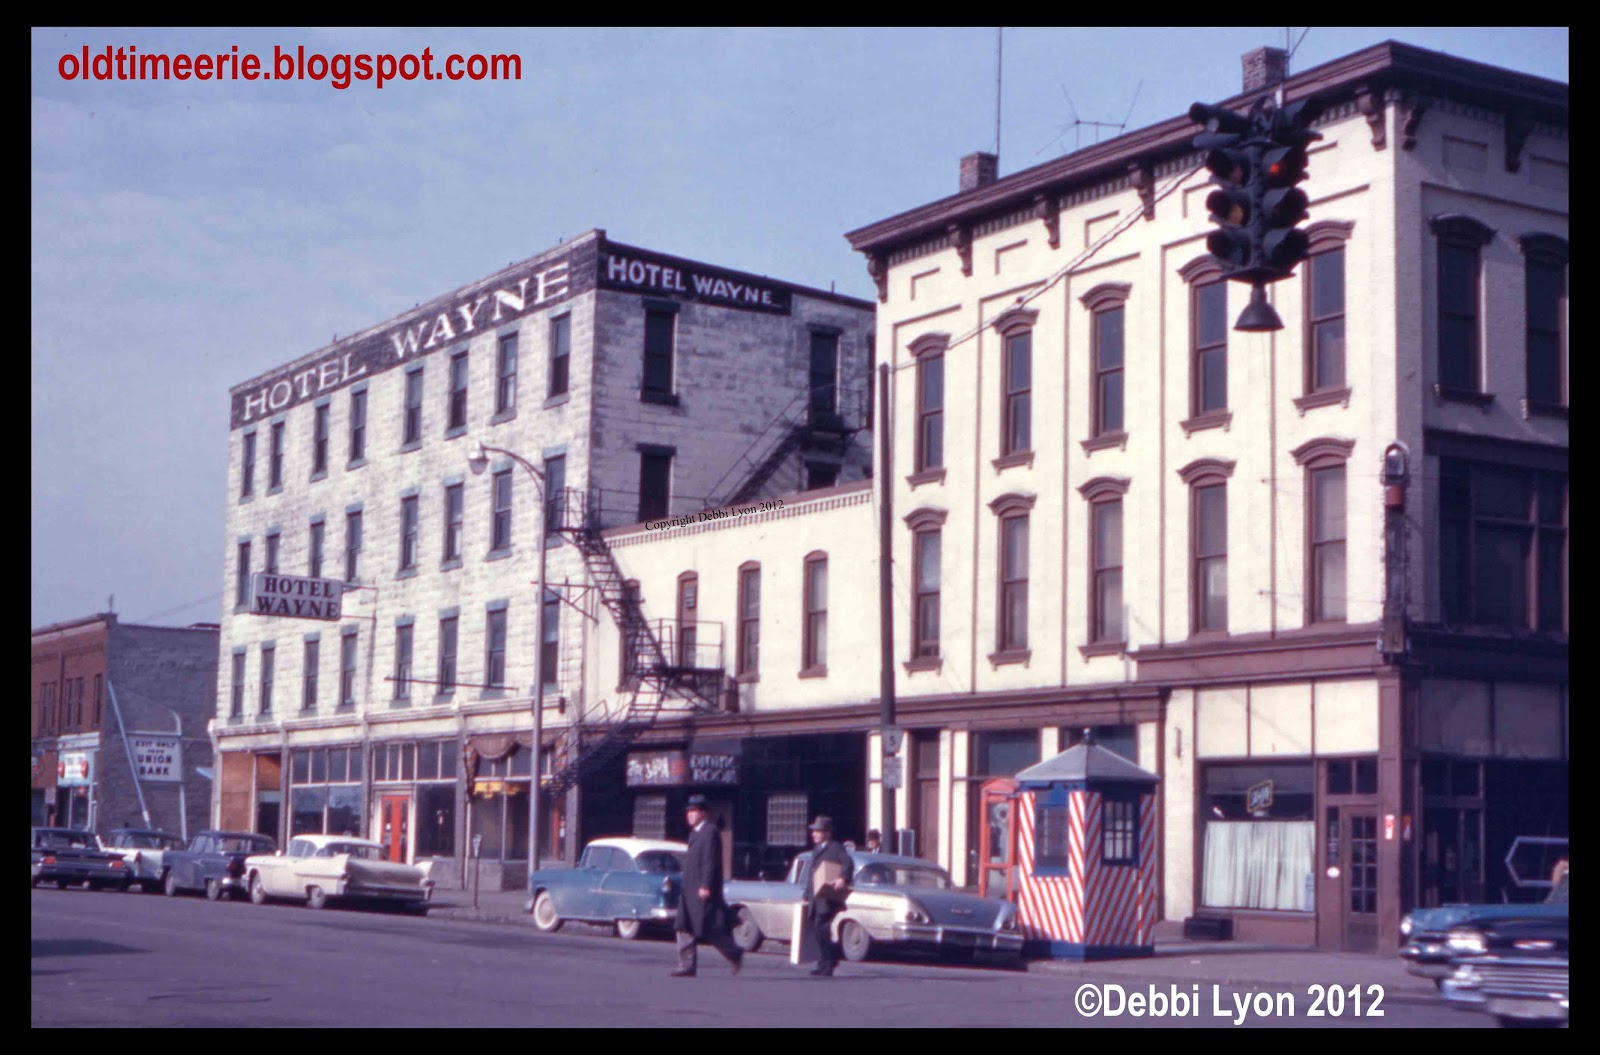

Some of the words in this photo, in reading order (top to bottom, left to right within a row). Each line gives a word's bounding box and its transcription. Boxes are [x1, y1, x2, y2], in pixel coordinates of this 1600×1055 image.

[608, 254, 687, 292] HOTEL
[692, 273, 772, 306] WAYNE
[242, 352, 367, 420] HOTEL
[389, 261, 570, 360] WAYNE
[264, 576, 335, 599] HOTEL
[256, 595, 339, 618] WAYNE
[137, 754, 172, 764] UNION
[139, 766, 169, 775] BANK
